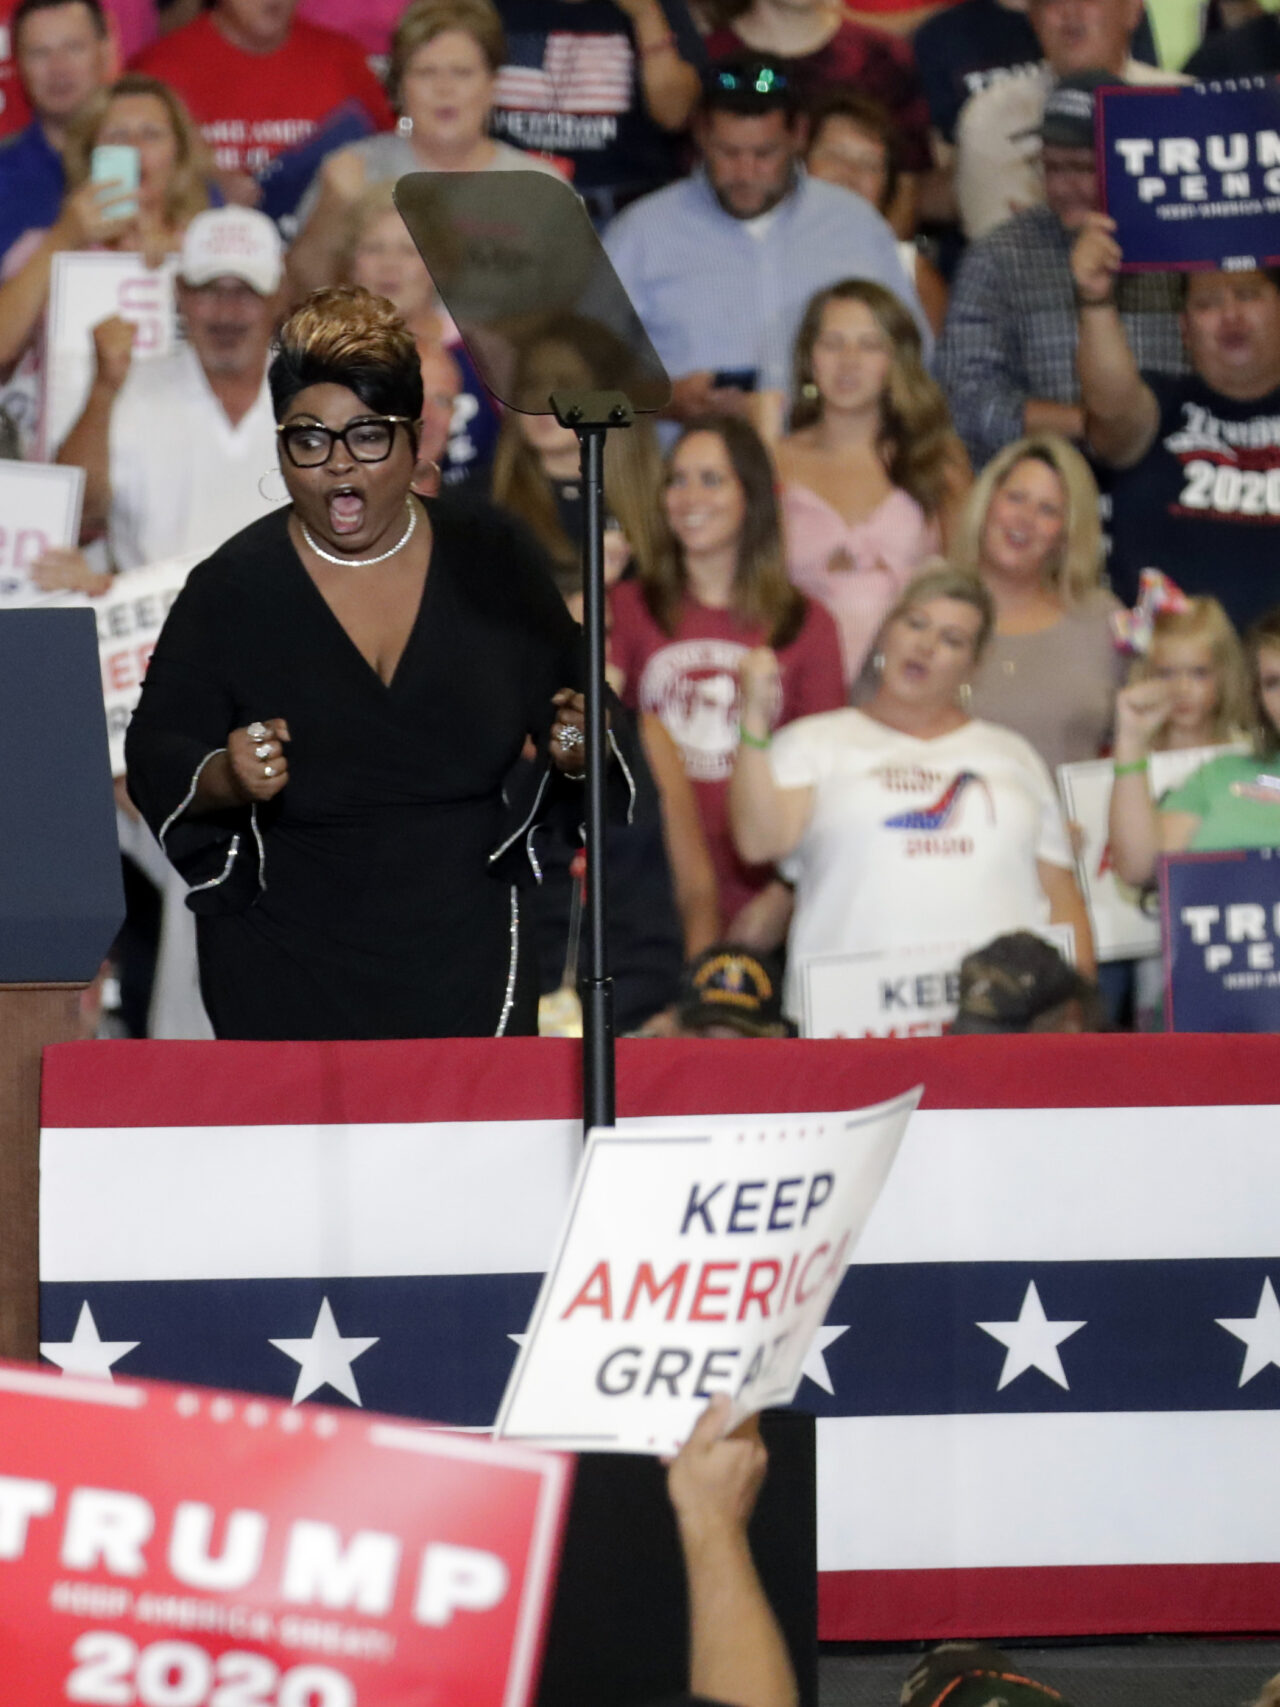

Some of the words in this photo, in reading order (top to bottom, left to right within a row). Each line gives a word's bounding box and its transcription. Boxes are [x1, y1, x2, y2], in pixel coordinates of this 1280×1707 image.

[100, 588, 180, 641] EE
[1180, 902, 1280, 945] TR
[678, 1171, 837, 1236] KEEP
[65, 1630, 357, 1707] 2020
